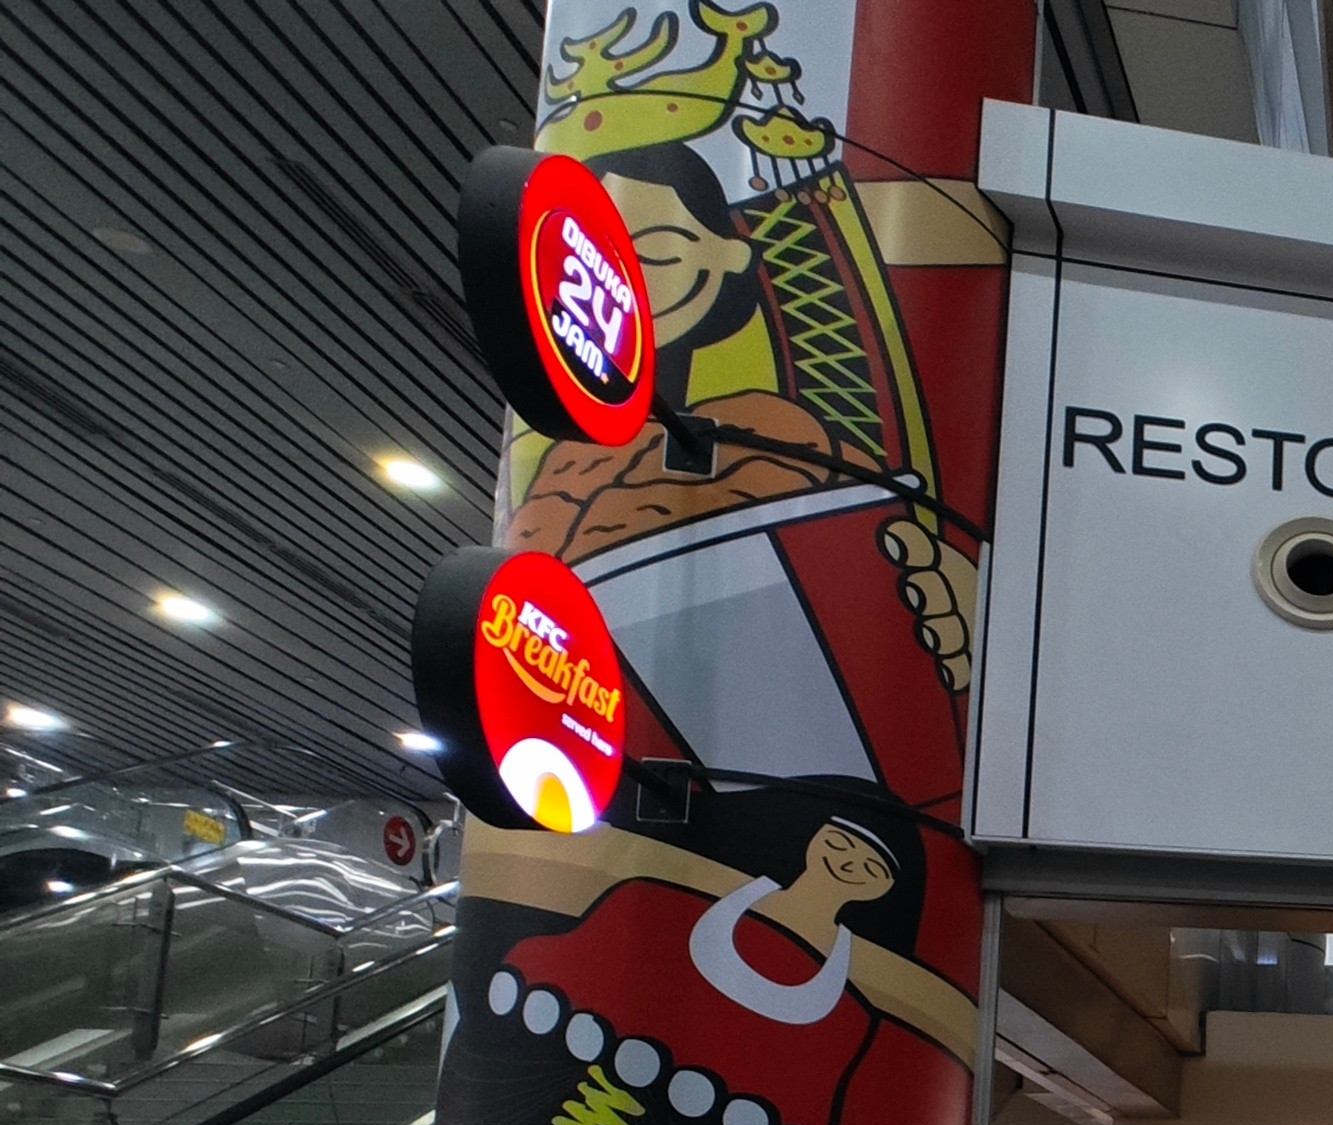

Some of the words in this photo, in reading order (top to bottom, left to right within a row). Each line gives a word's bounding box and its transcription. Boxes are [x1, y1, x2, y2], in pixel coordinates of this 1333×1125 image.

[558, 255, 622, 355] 24
[562, 216, 632, 313] DIBUKA
[552, 310, 603, 377] JAM
[481, 594, 621, 723] Breakfast
[517, 601, 568, 653] KFC
